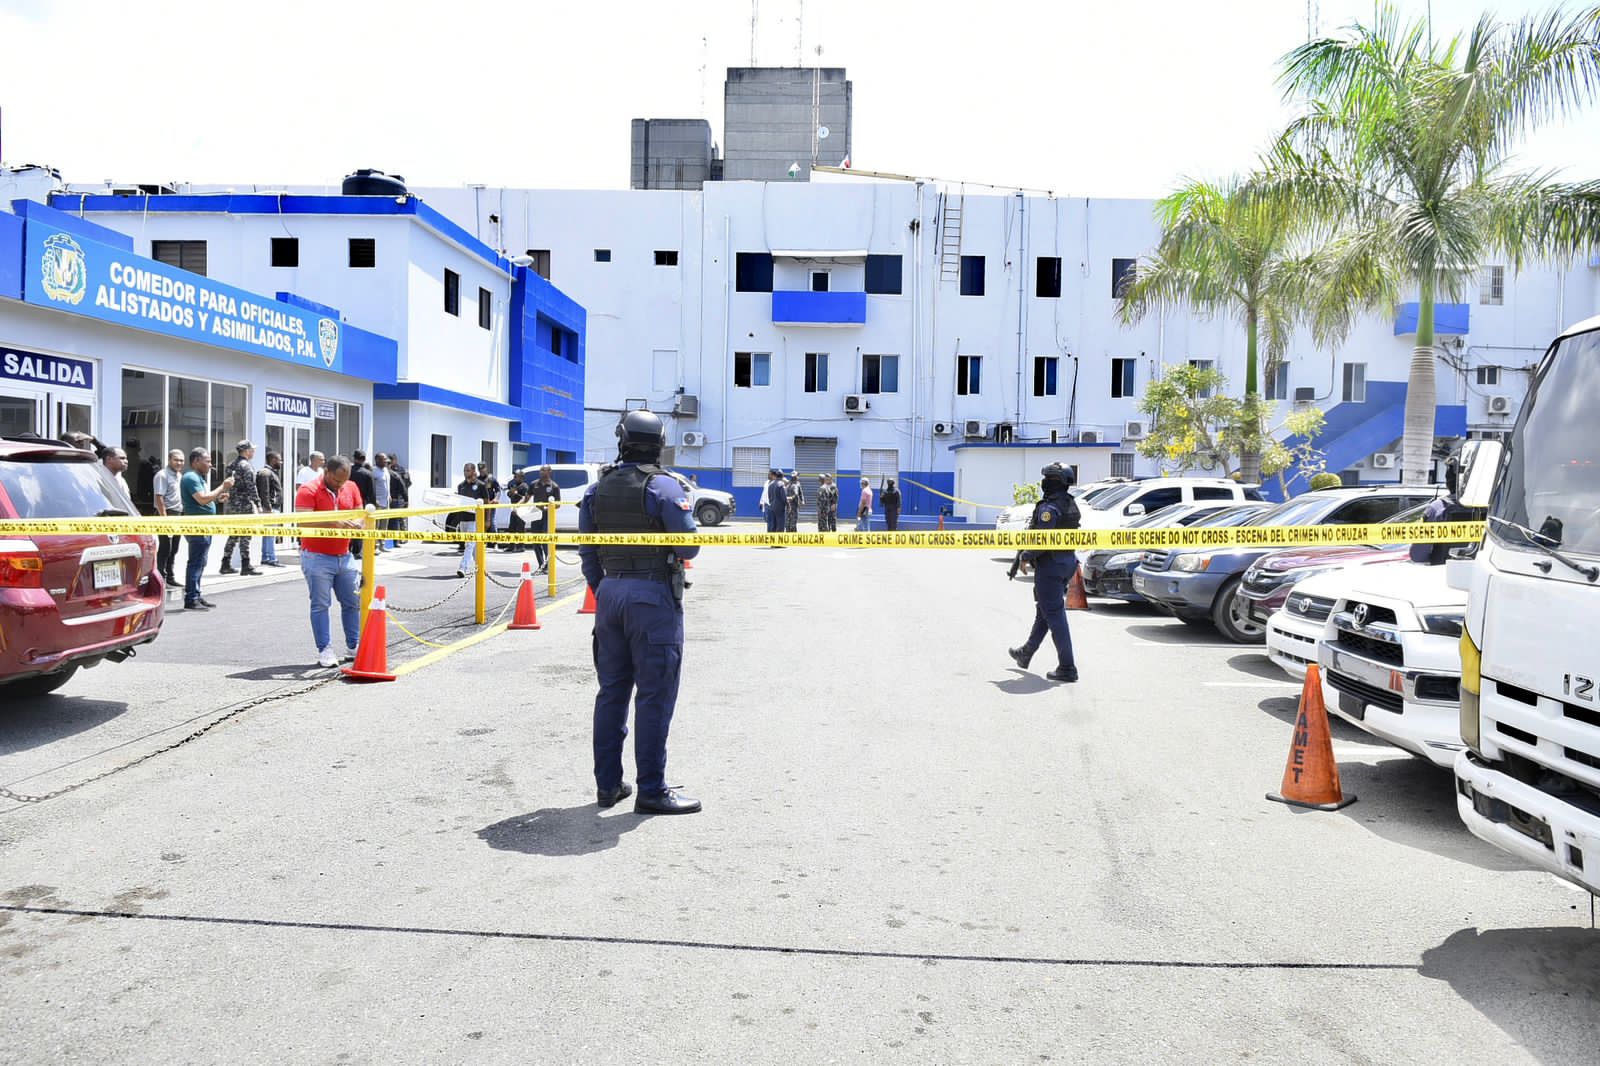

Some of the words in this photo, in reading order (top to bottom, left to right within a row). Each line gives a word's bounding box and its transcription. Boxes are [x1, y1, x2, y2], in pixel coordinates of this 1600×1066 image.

[110, 262, 195, 305] COMEDOR
[200, 288, 237, 317] PARA
[241, 301, 307, 339] OFICIALES,
[95, 284, 194, 328] ALISTADOS
[197, 311, 208, 331] Y
[212, 316, 295, 357] ASIMILADOS,
[297, 338, 316, 358] P.N.
[4, 353, 86, 385] SALIDA
[266, 395, 308, 416] ENTRADA
[571, 535, 596, 543] CRIME
[599, 535, 625, 543] SCENE
[627, 535, 638, 543] DO
[641, 535, 656, 543] NOT
[660, 535, 686, 543] CROSS
[693, 535, 724, 544] ESCENA
[727, 535, 740, 544] DEL
[745, 535, 775, 544] CRIMEN
[778, 535, 789, 544] NO
[792, 534, 825, 544] CRUZAR
[838, 534, 863, 544] CRIME
[866, 534, 892, 544] SCENE
[895, 534, 907, 544] DO
[910, 534, 925, 544] NOT
[928, 534, 955, 545] CROSS
[963, 533, 995, 545] ESCENA
[998, 533, 1013, 545] DEL
[1015, 533, 1047, 545] CRIMEN
[1050, 533, 1061, 545] NO
[1064, 532, 1097, 545] CRUZAR
[1110, 532, 1137, 545] CRIME
[1140, 532, 1166, 545] SCENE
[1168, 531, 1179, 544] DO
[1182, 531, 1199, 544] NOT
[1201, 531, 1228, 544] CROSS
[1236, 530, 1268, 543] ESCENA
[1270, 529, 1286, 543] DEL
[1288, 529, 1319, 542] CRIMEN
[1322, 528, 1333, 541] NO
[1336, 527, 1369, 541] CRUZAR
[1381, 526, 1406, 540] CRIME
[1409, 526, 1434, 539] SCENE
[1437, 525, 1447, 539] DO
[1451, 525, 1467, 538] NOT
[1563, 673, 1600, 703] 12
[1292, 712, 1308, 784] AMET
